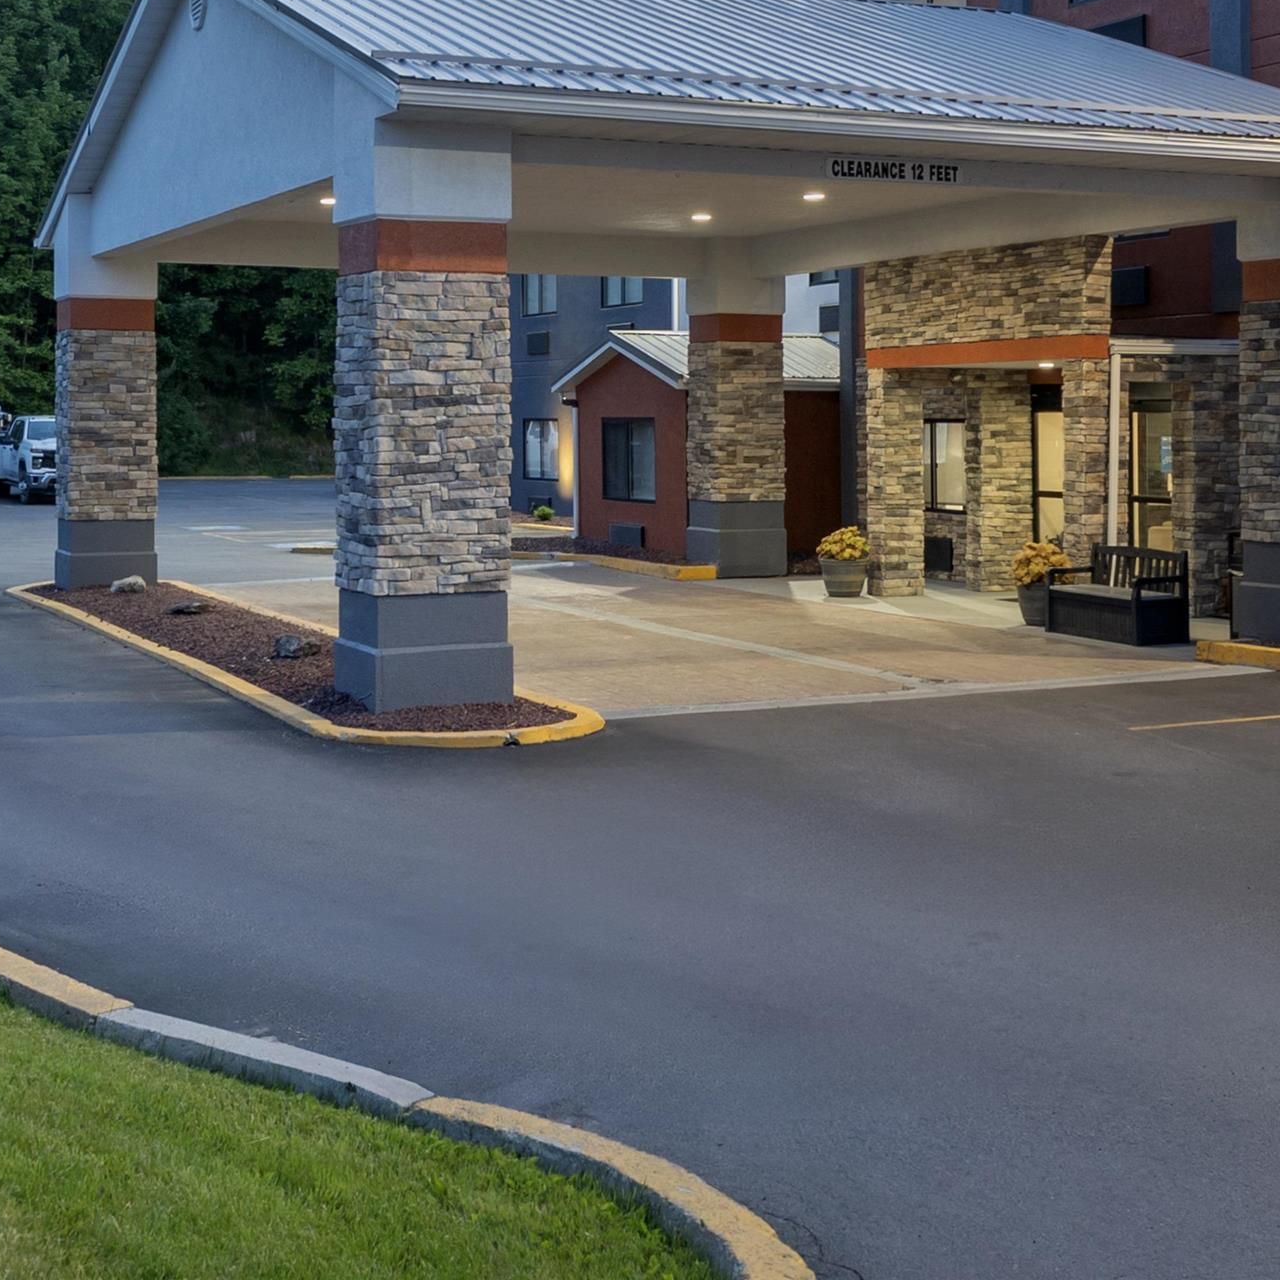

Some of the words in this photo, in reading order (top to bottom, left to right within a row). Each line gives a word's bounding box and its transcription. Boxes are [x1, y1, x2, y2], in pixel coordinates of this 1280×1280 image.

[831, 159, 905, 179] CLEARANCE
[911, 163, 924, 180] 12
[929, 164, 959, 182] FEET
